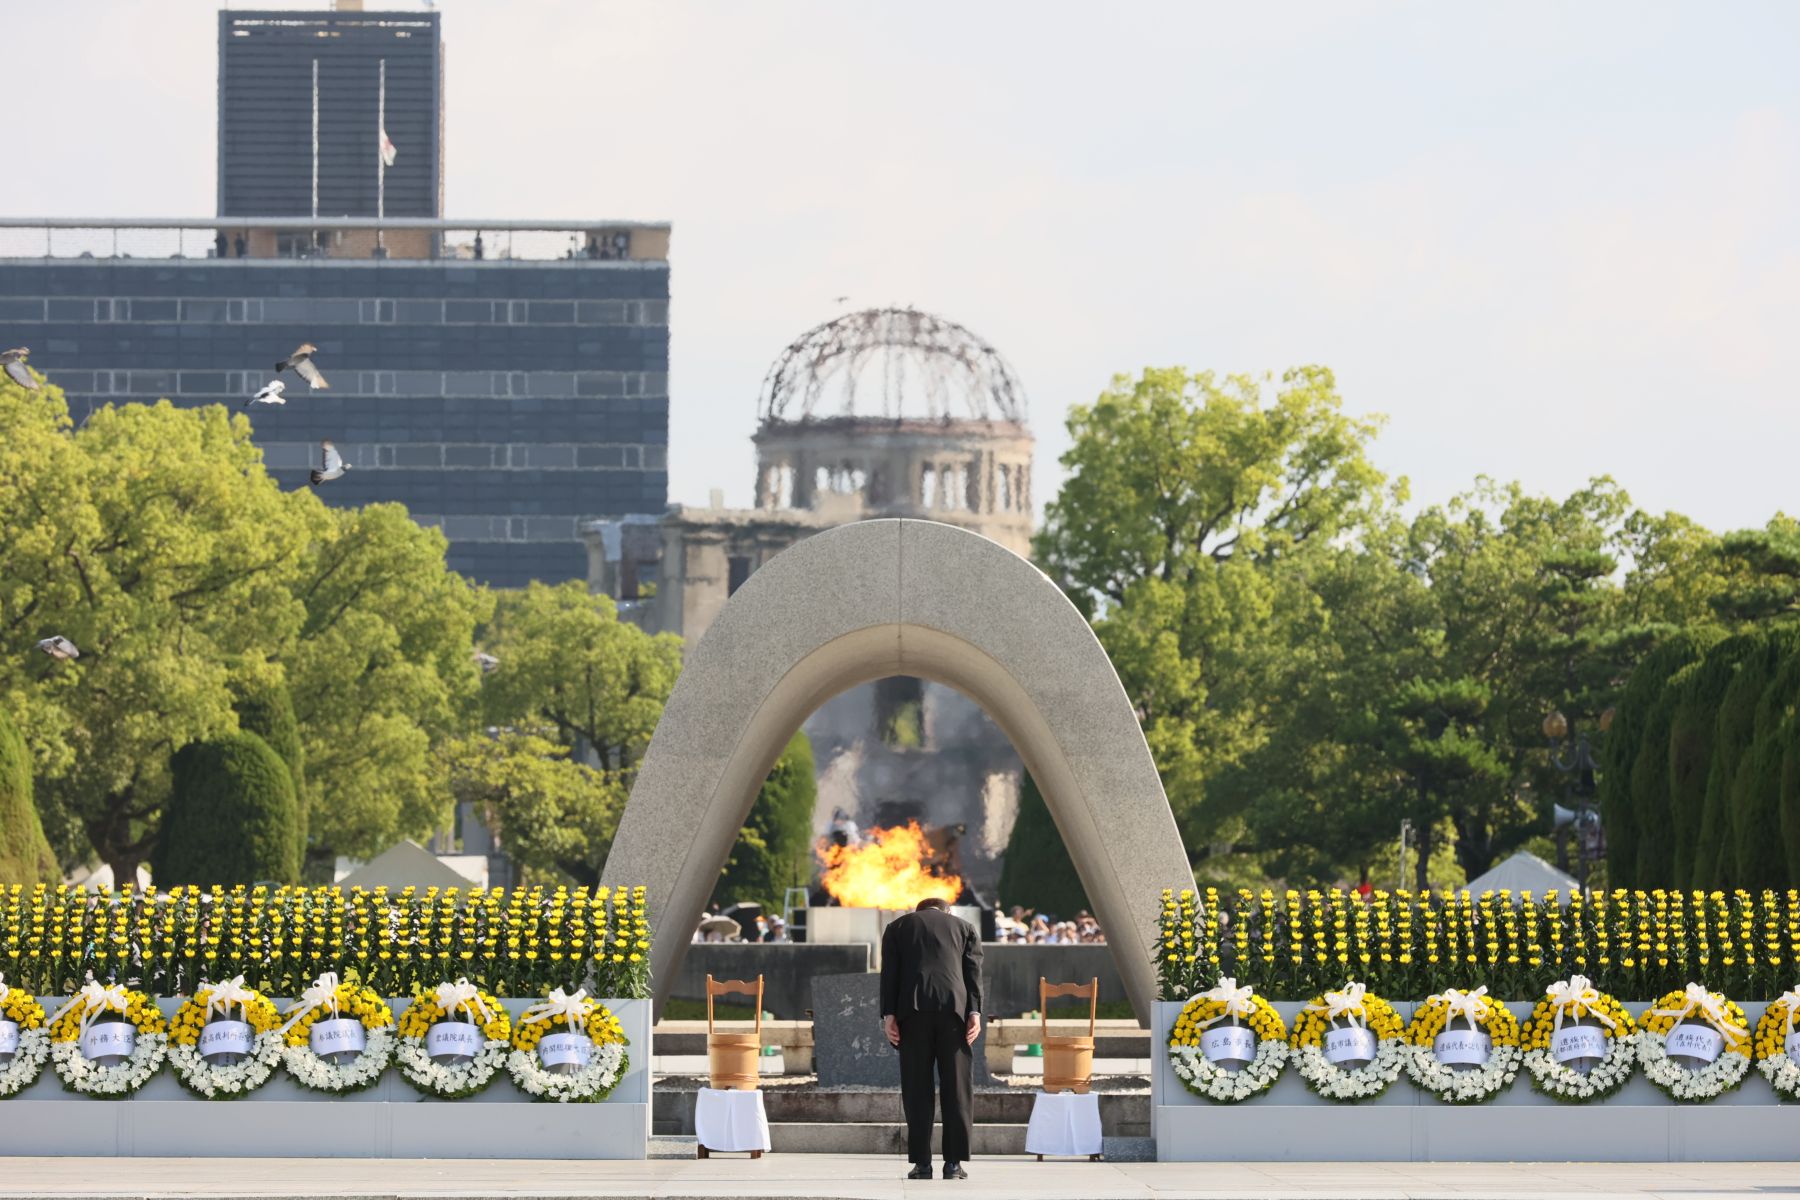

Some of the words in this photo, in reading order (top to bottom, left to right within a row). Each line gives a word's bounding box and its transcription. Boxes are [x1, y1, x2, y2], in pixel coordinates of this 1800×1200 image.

[90, 1033, 132, 1047] 外務大臣
[1211, 1036, 1253, 1048] 広島市長
[1675, 1033, 1713, 1046] 遺族代表
